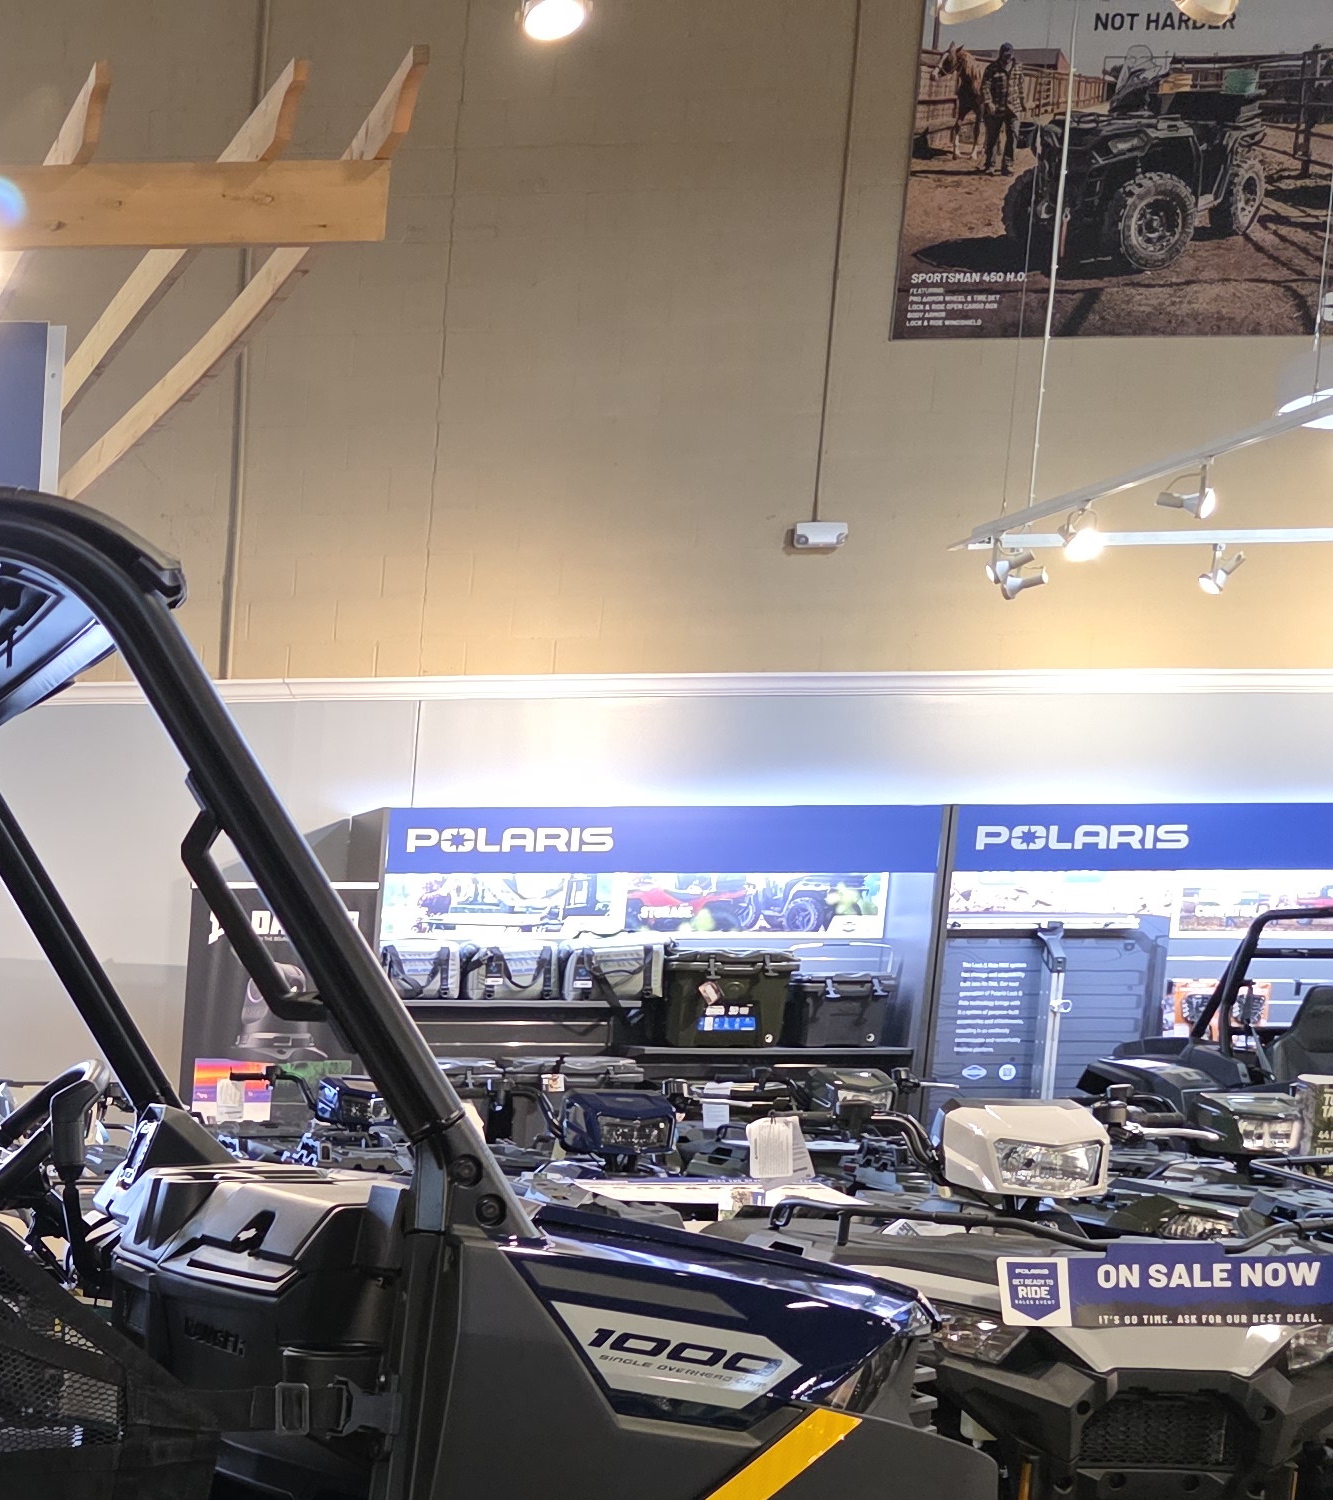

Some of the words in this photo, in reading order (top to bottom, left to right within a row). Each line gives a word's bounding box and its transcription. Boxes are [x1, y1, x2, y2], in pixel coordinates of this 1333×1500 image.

[1094, 13, 1139, 30] NOT
[911, 273, 980, 283] SPORTSMAN
[983, 273, 1004, 282] 450
[406, 827, 614, 853] POLARIS
[975, 824, 1189, 850] POLARIS
[1097, 1264, 1140, 1288] ON
[1148, 1263, 1232, 1288] SALE
[1240, 1262, 1321, 1287] NOW
[1017, 1286, 1051, 1299] RIDE
[1098, 1315, 1120, 1325] IT'S
[1124, 1315, 1138, 1324] GO
[1143, 1315, 1173, 1324] TIME.
[1177, 1314, 1197, 1324] ASK
[1202, 1315, 1222, 1324] FOR
[1226, 1314, 1247, 1324] OUR
[1253, 1314, 1282, 1323] BEST
[1286, 1313, 1323, 1323] DEAL.
[587, 1327, 783, 1377] 1000
[599, 1354, 653, 1368] SINGLE
[657, 1364, 733, 1382] OVERHEAD
